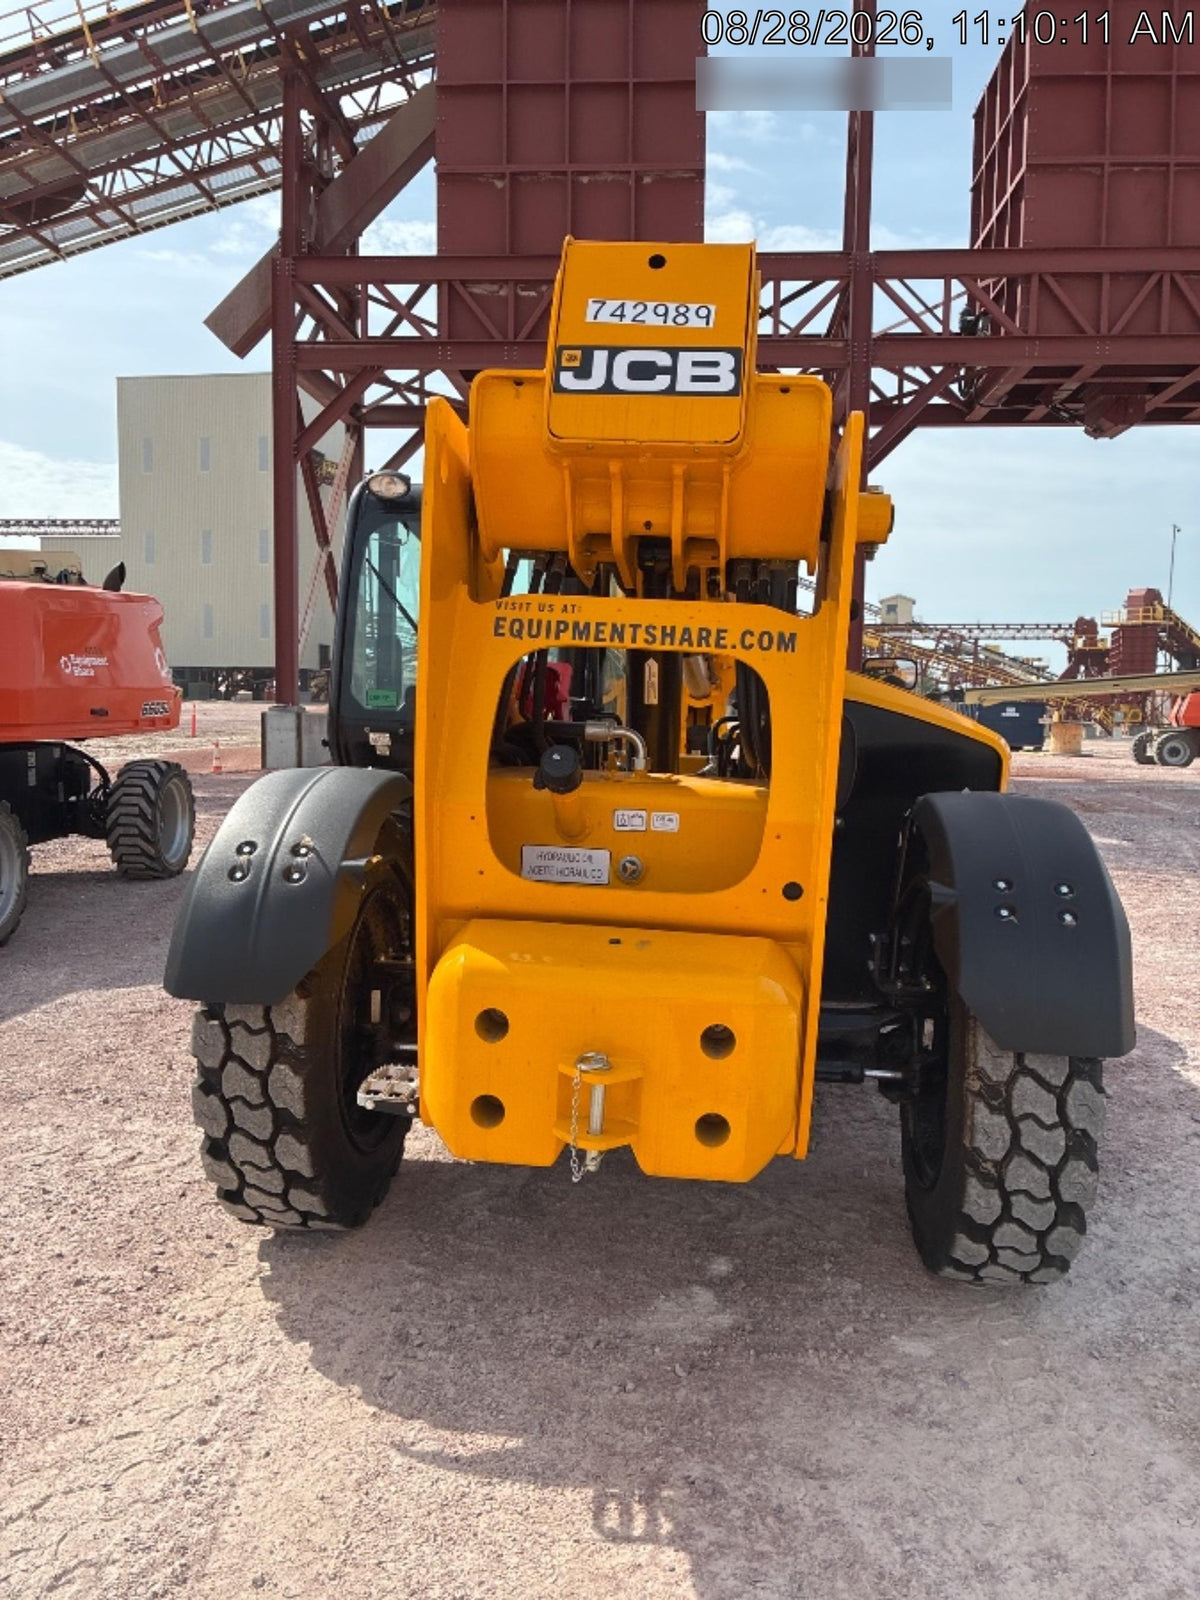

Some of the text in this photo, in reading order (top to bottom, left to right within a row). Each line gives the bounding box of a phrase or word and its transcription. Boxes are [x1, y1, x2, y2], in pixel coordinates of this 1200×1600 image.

[591, 300, 712, 327] 742989
[559, 350, 736, 392] JCB
[495, 600, 583, 614] VISIT US AT:
[493, 616, 798, 653] EQUIPMENTSHARE.COM
